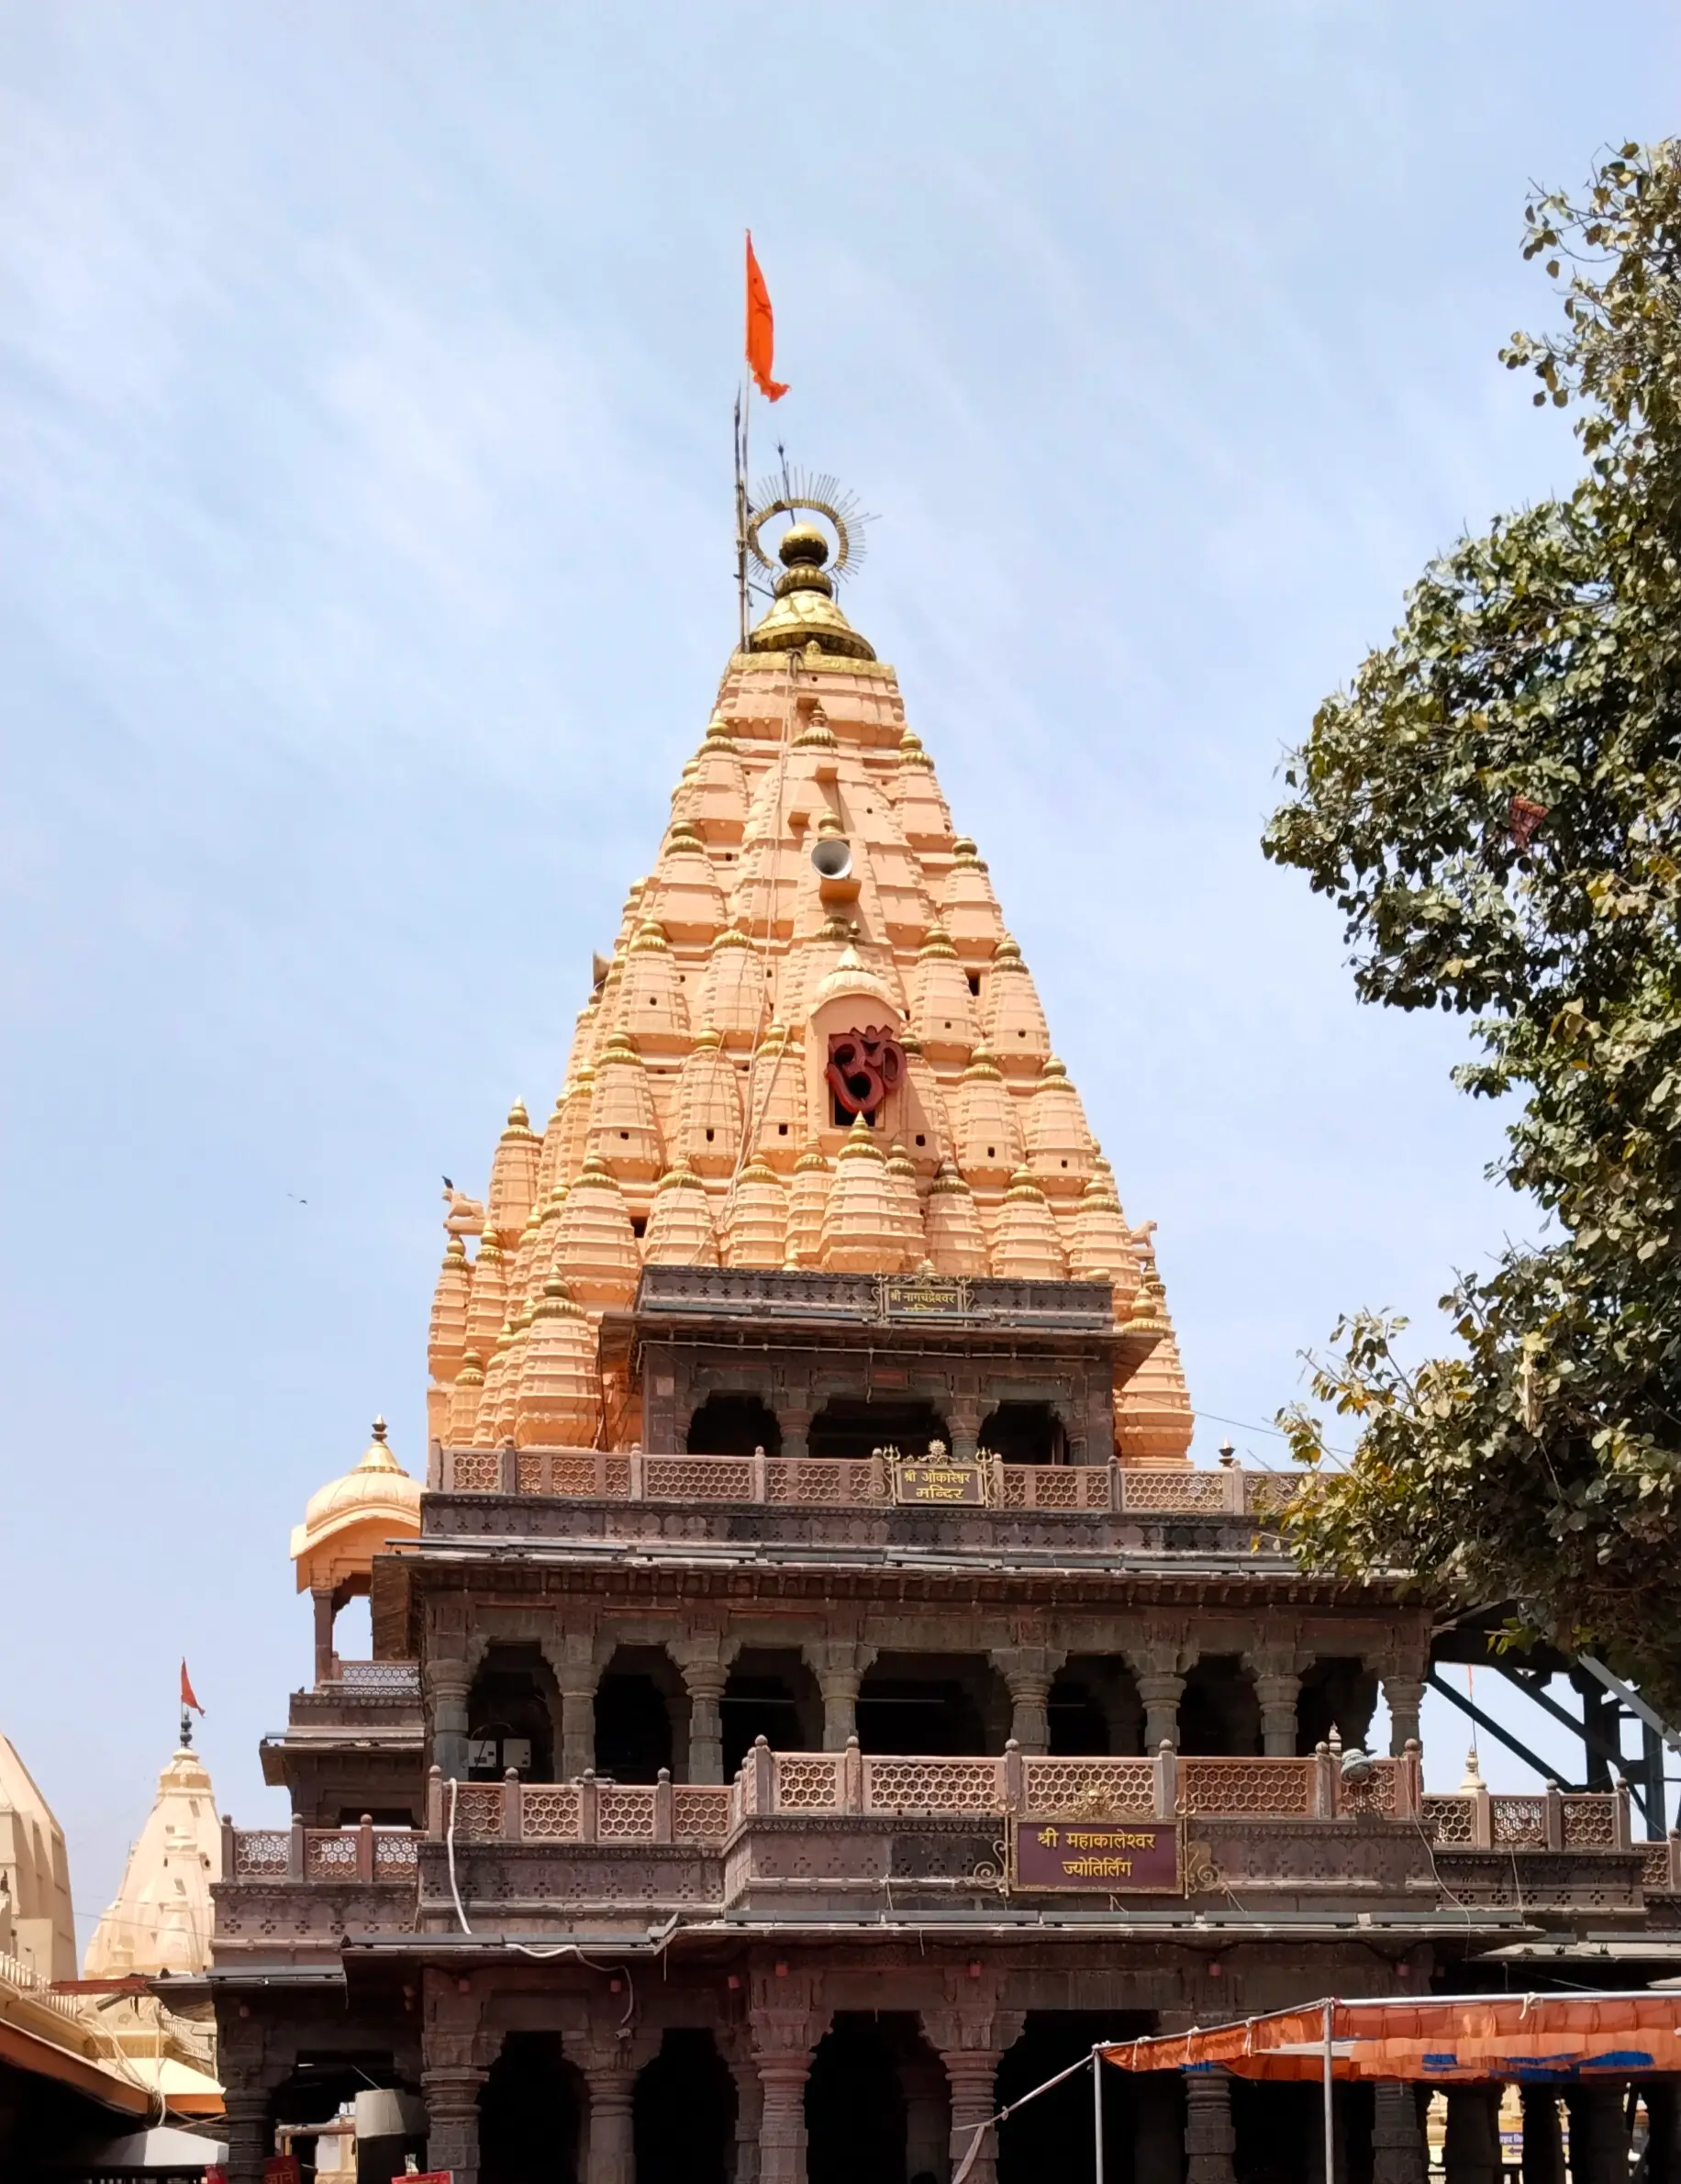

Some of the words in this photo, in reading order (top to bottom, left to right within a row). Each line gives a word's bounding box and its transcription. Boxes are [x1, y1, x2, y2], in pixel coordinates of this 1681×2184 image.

[890, 1288, 901, 1302] श्री
[904, 1469, 917, 1482] श्री
[916, 1485, 964, 1499] मन्दिर
[1037, 1826, 1059, 1848] श्री
[1065, 1828, 1156, 1850] महाकालेश्वर
[1062, 1855, 1132, 1877] ज्योतिर्लिंग
